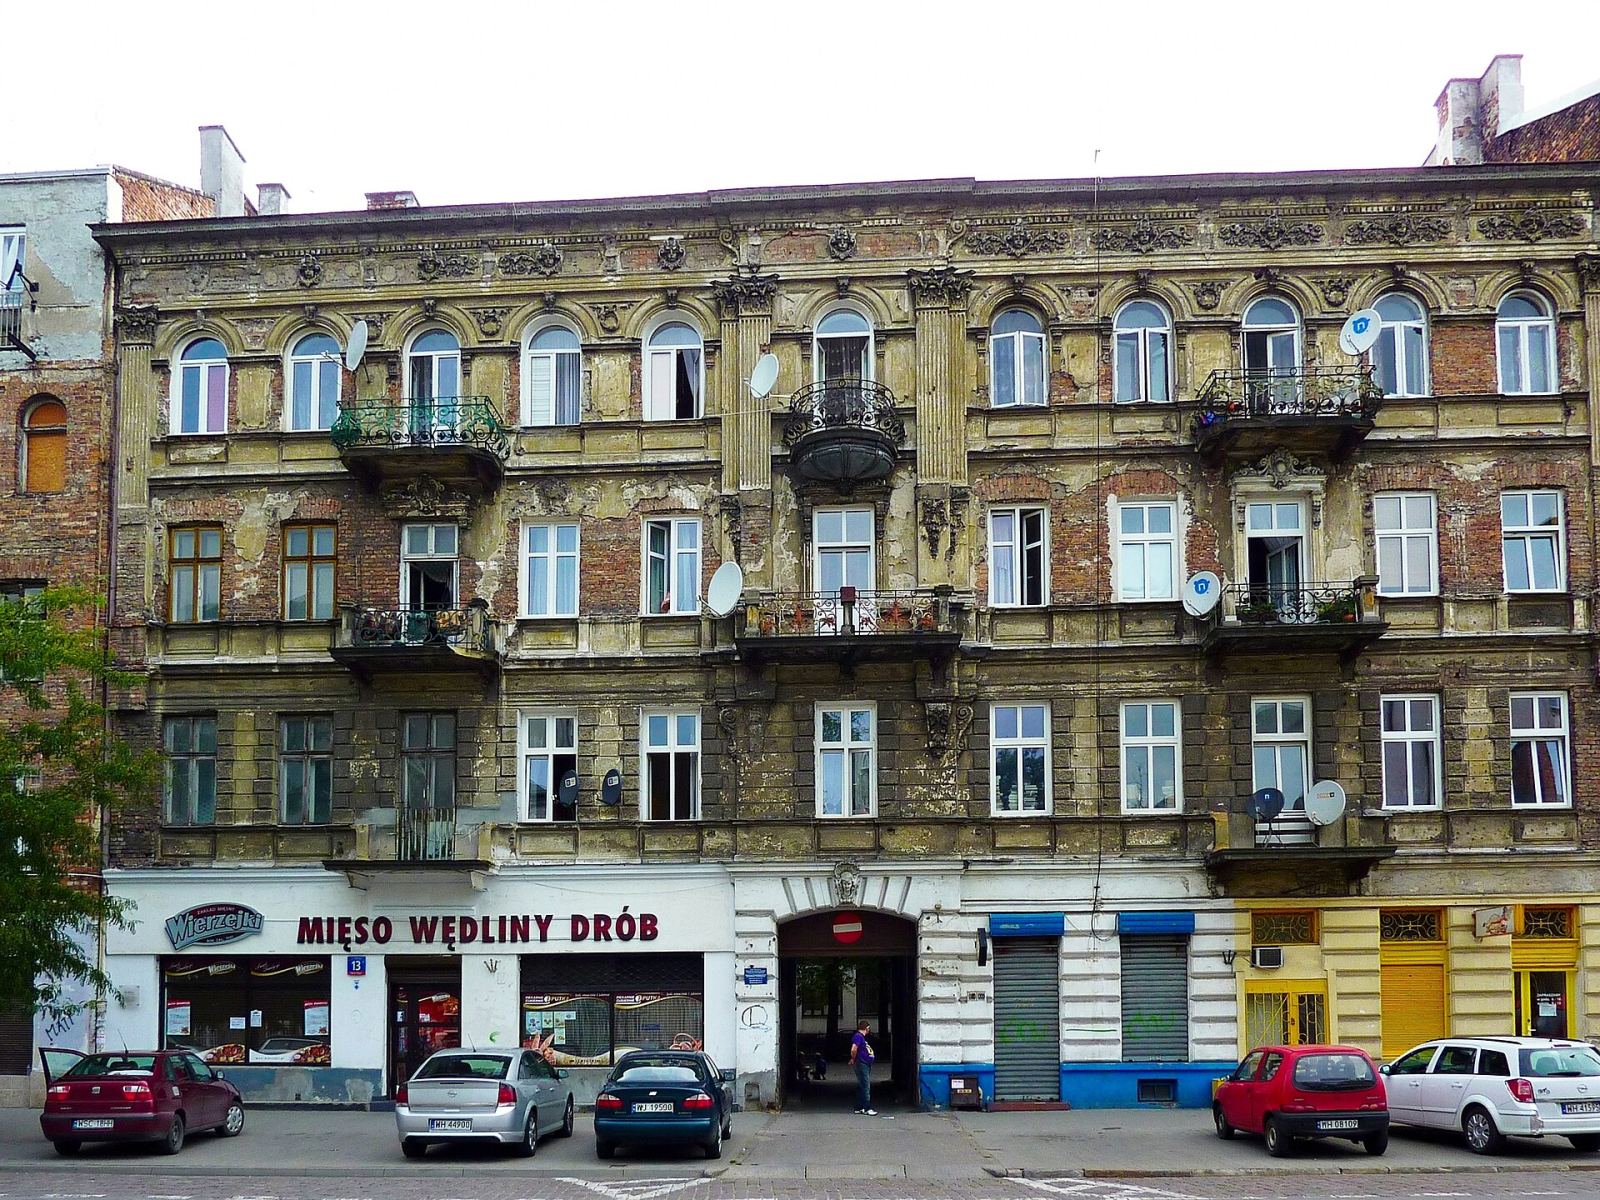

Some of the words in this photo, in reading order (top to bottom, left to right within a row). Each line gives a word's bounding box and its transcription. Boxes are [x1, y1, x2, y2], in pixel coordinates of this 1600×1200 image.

[165, 910, 263, 946] Wierzejki
[297, 916, 393, 952] MIĘSO
[409, 914, 554, 951] WĘDLINY
[571, 905, 659, 942] DRÓB
[351, 960, 361, 971] 13
